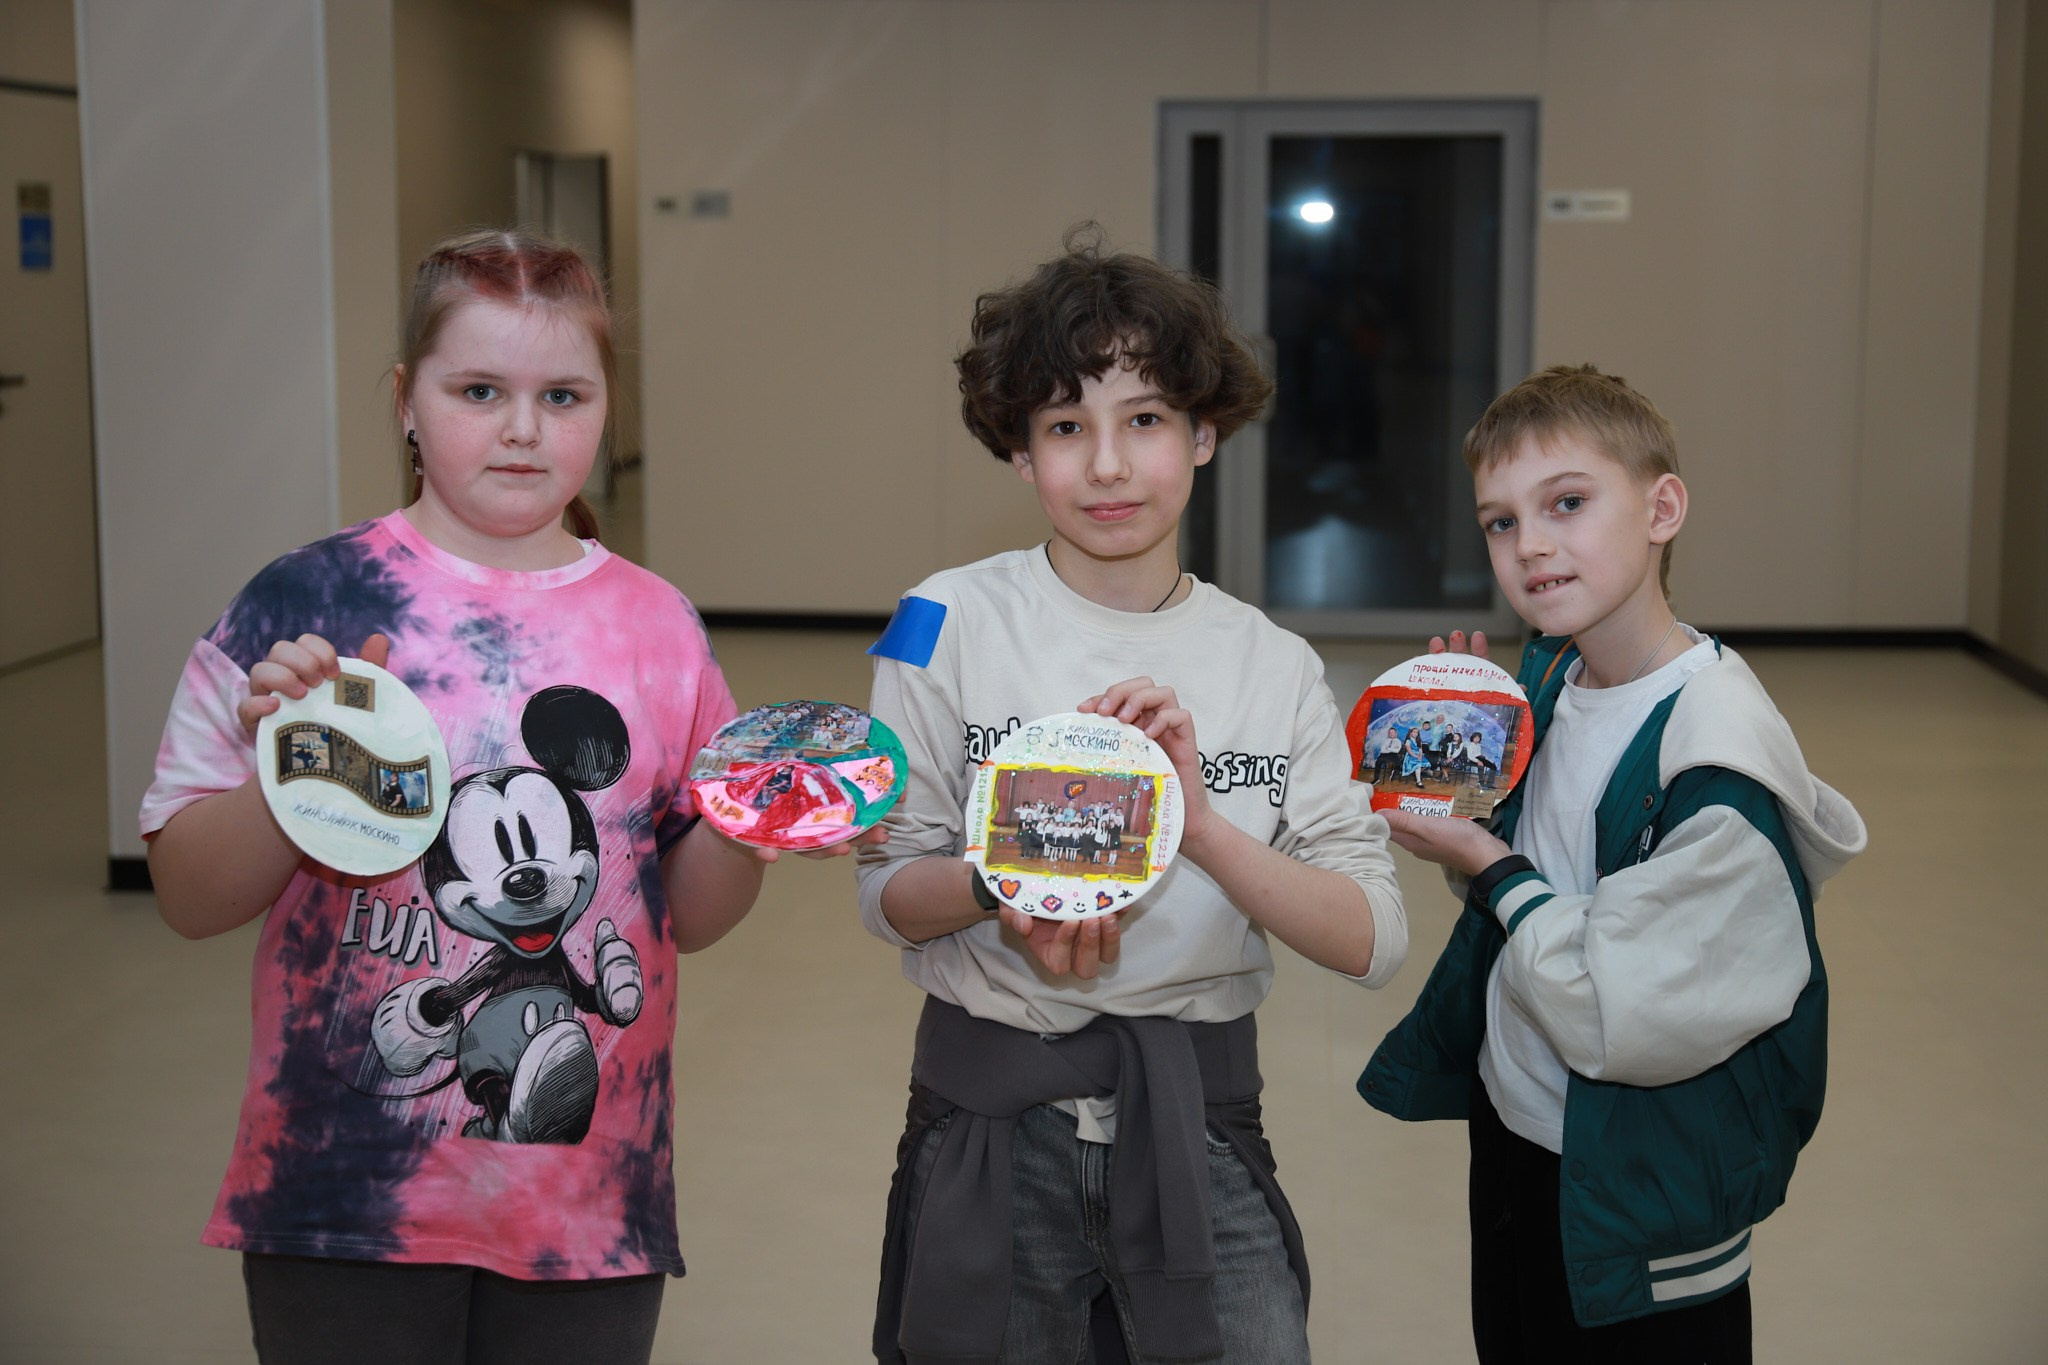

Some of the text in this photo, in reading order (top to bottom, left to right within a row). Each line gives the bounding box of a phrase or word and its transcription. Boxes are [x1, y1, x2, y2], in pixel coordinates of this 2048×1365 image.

[1065, 734, 1120, 751] МОСКИНО
[1067, 724, 1123, 738] КИНОПАРК
[1162, 781, 1175, 819] Школа
[293, 803, 400, 845] КИНОПАРК МОСКИНО
[972, 807, 983, 845] Школа
